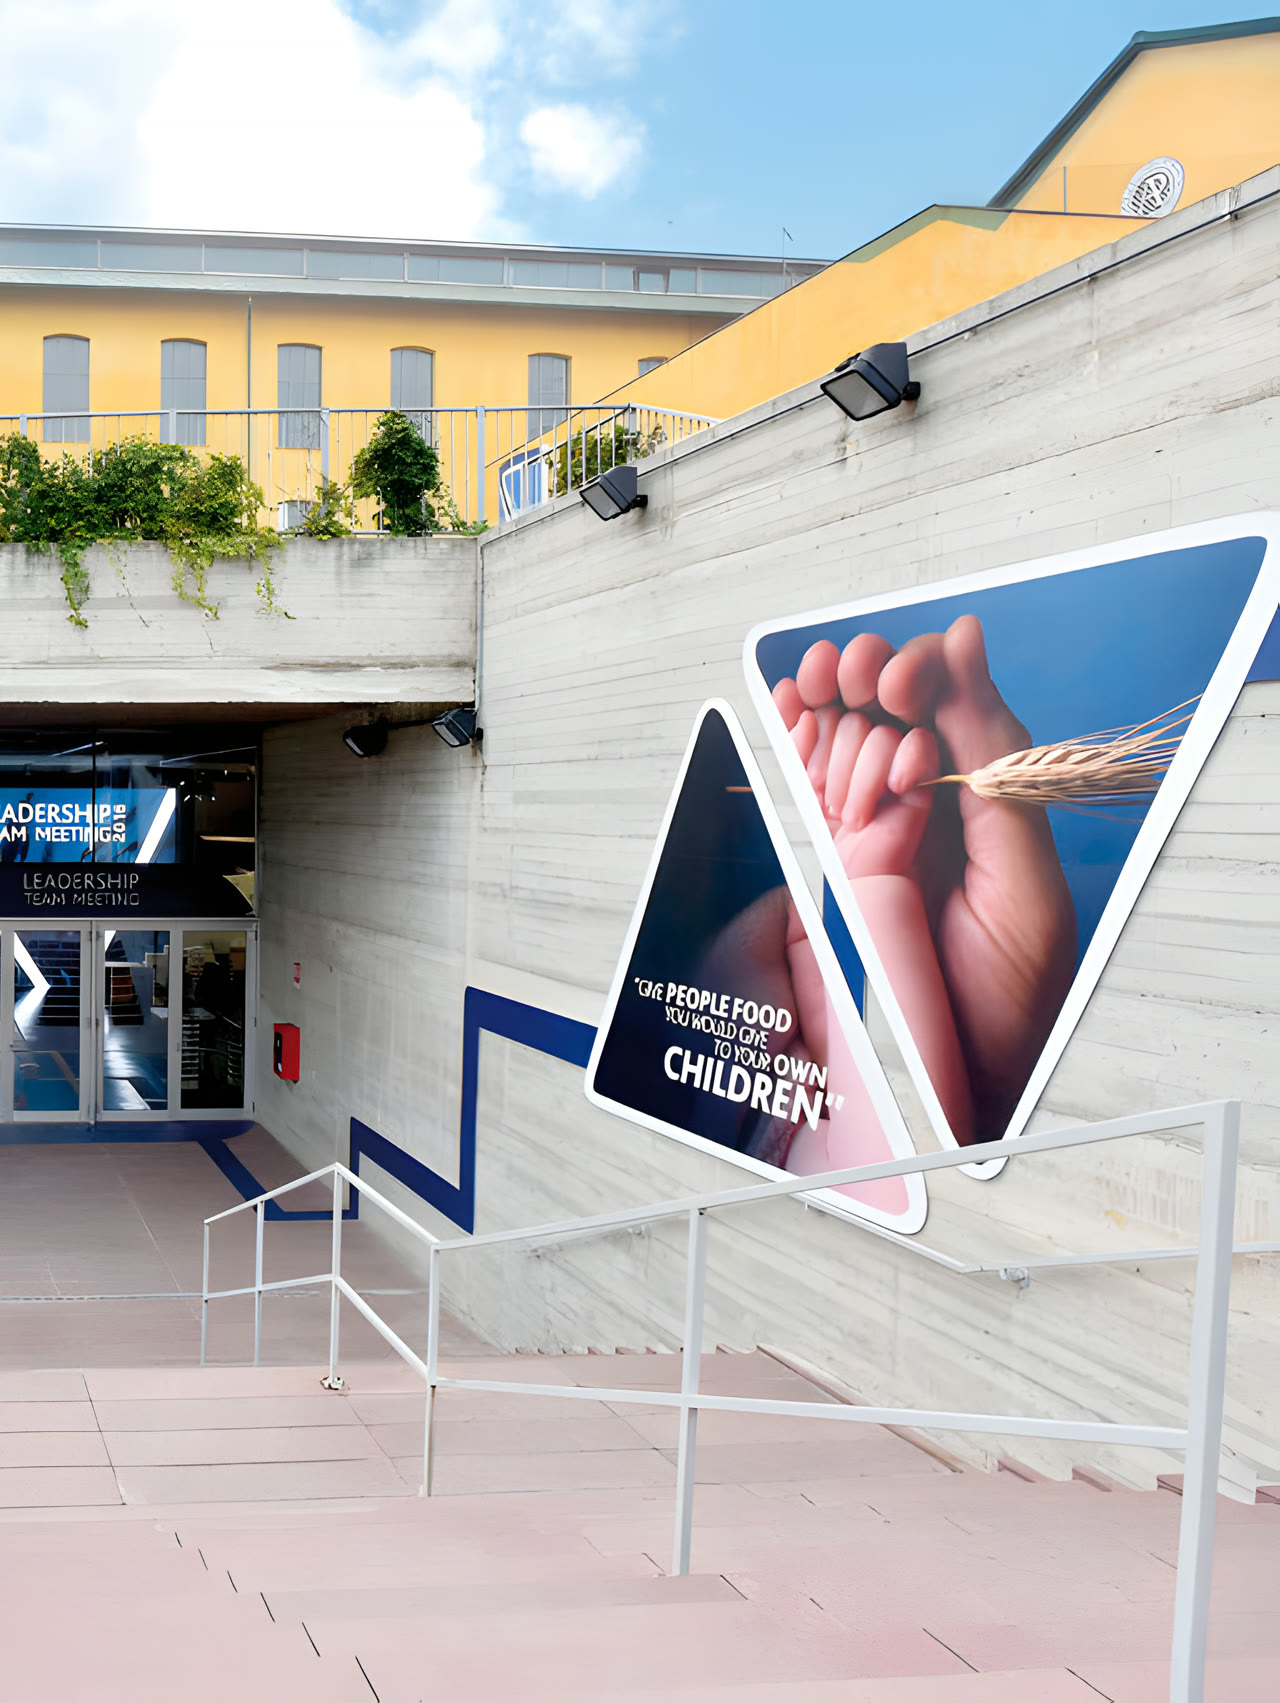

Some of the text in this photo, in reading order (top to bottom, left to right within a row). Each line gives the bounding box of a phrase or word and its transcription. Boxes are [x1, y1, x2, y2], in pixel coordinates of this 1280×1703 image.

[35, 826, 111, 843] MEETING
[23, 873, 139, 889] LEADERSHIP
[24, 892, 65, 905] TEAM
[666, 982, 730, 1018] PEOPLE
[732, 997, 792, 1033] FOOD
[714, 1038, 732, 1059] TO
[774, 1054, 828, 1089] OWN
